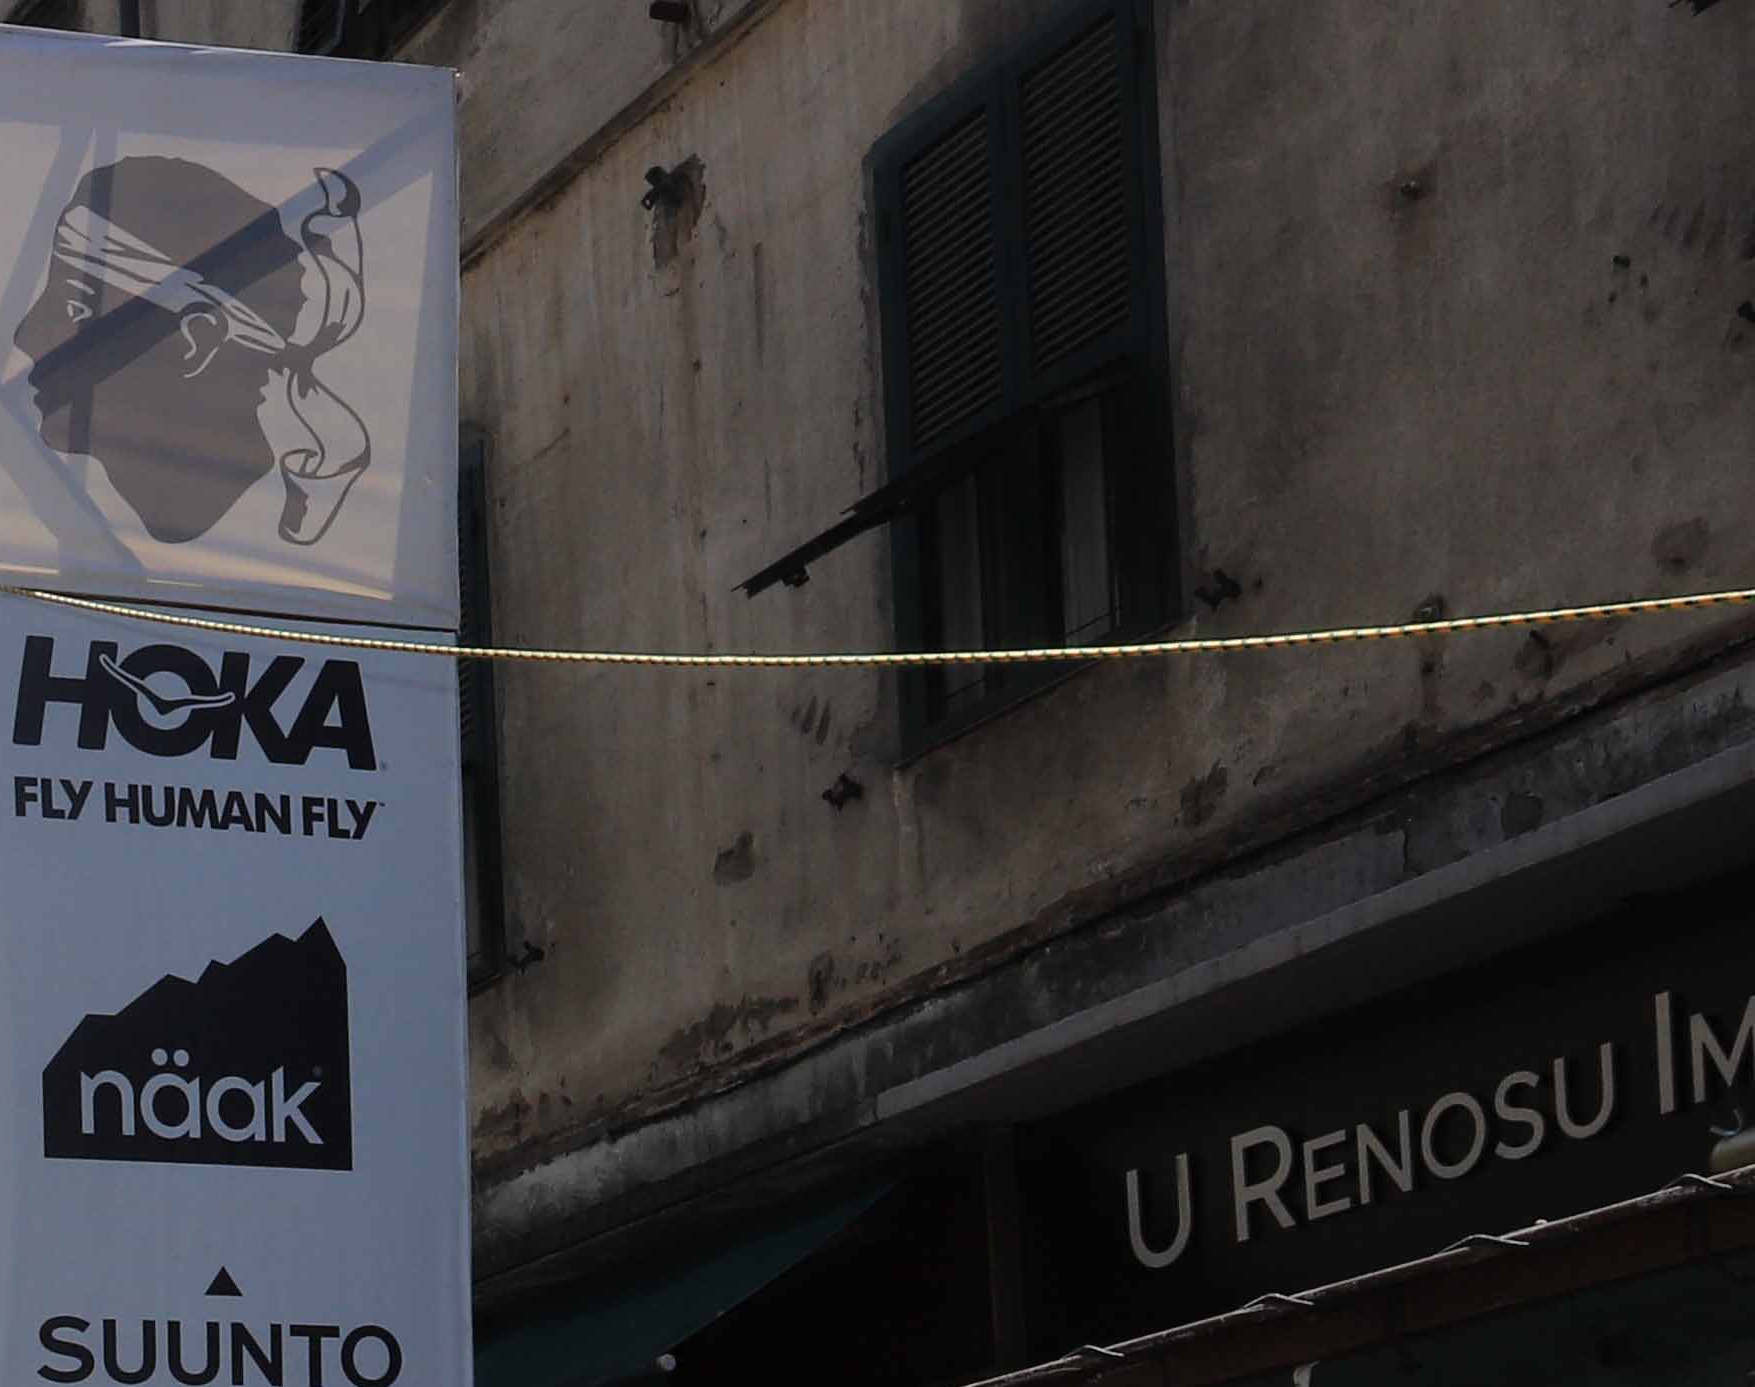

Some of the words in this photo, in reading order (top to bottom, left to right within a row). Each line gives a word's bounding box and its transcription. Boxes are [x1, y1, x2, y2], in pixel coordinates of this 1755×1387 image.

[13, 635, 377, 772] HOKA
[14, 775, 92, 821] FLY
[104, 782, 291, 836] HUMAN
[302, 796, 376, 840] FLY
[80, 1048, 323, 1145] näak
[1126, 1153, 1189, 1269] U
